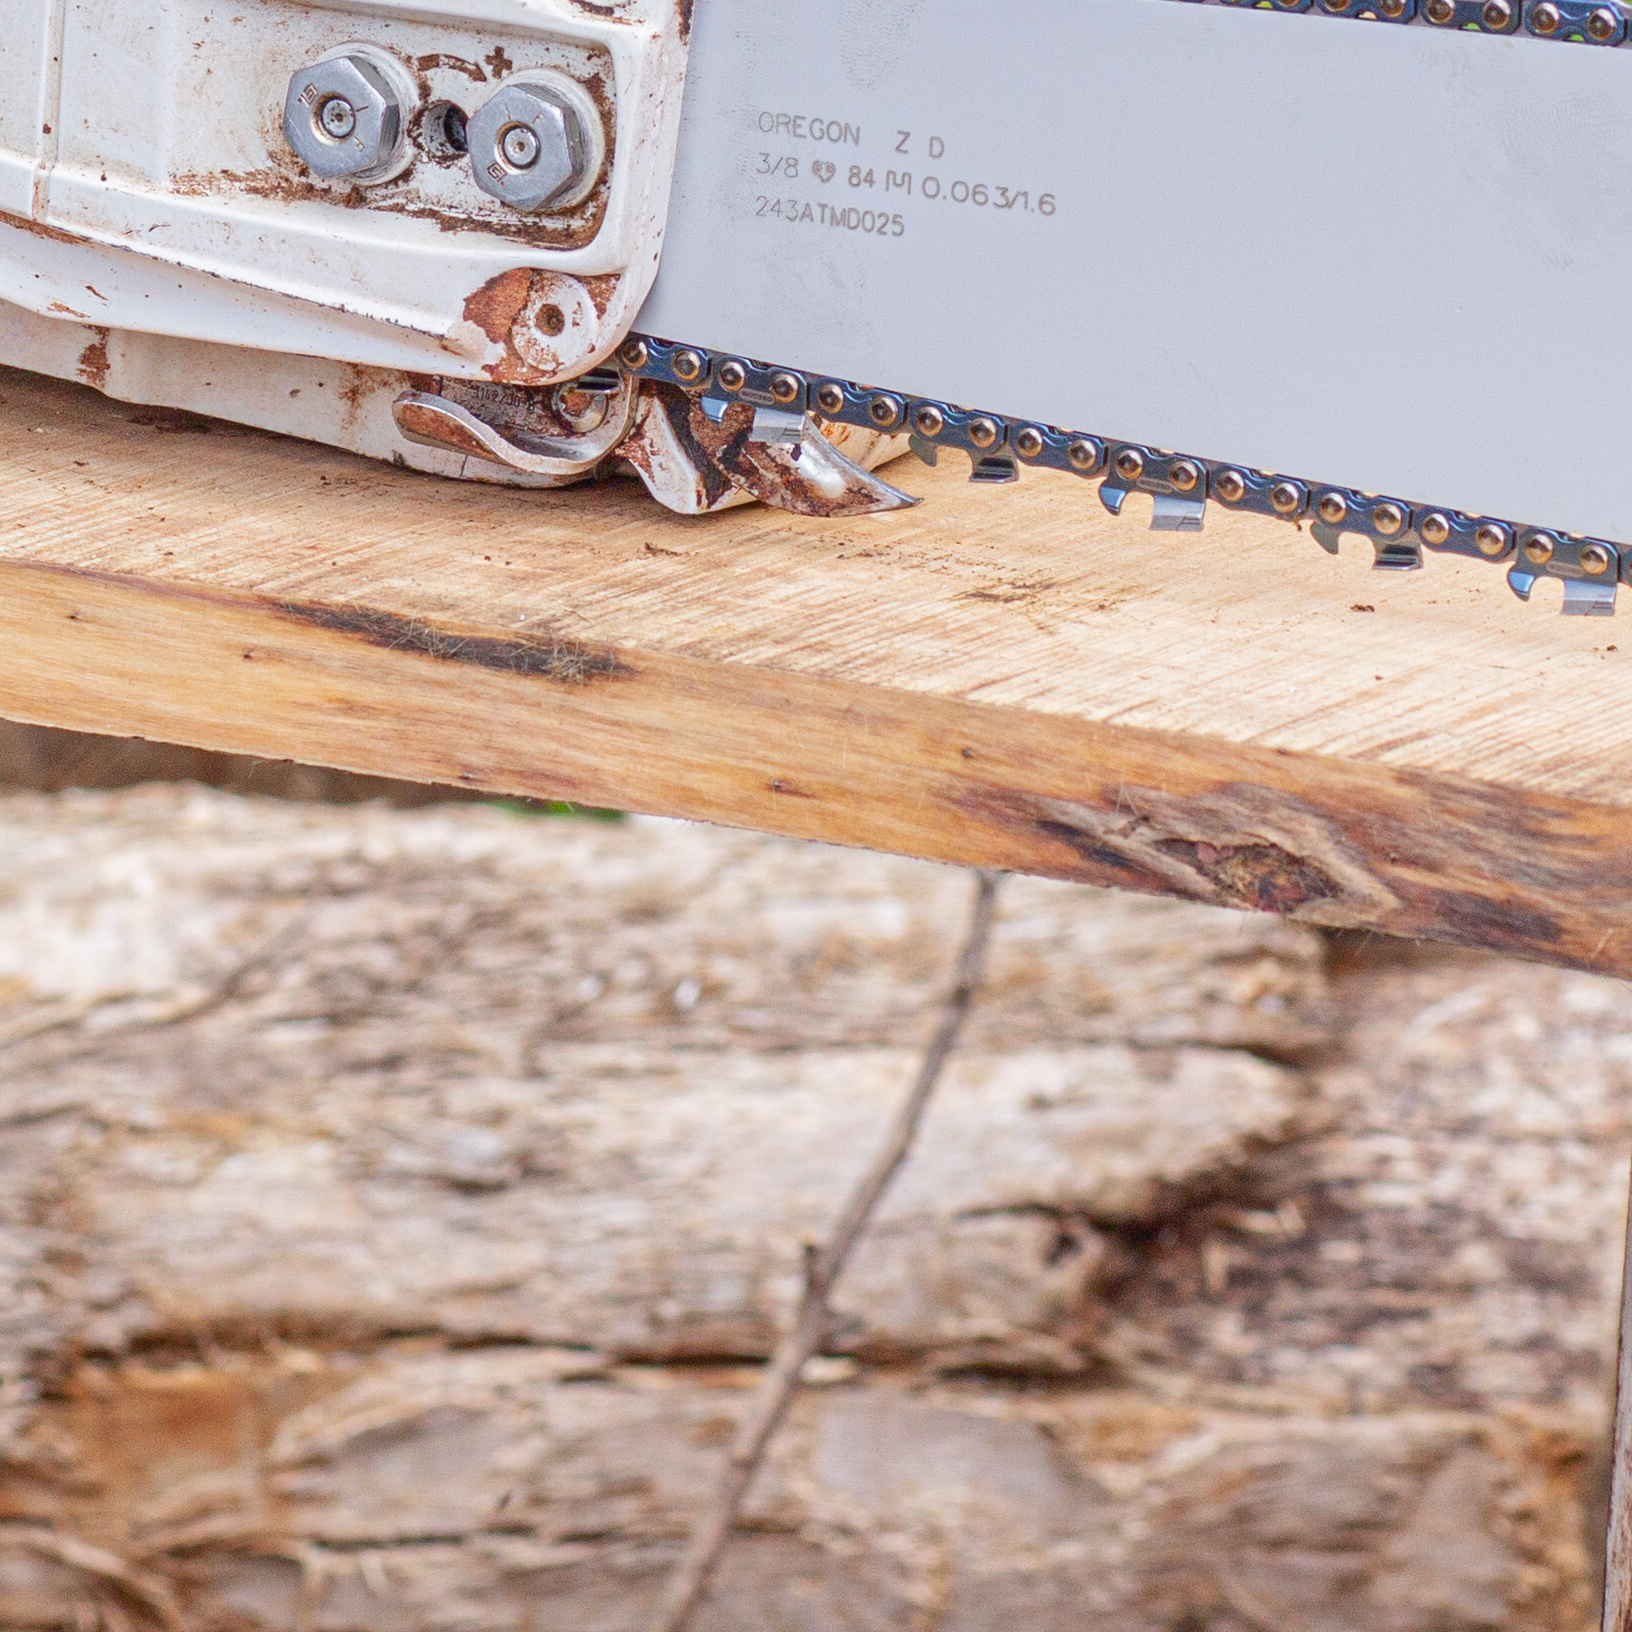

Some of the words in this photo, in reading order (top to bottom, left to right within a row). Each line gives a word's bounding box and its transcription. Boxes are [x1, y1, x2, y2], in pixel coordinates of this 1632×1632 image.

[758, 111, 861, 146] OREGON
[895, 130, 911, 154] Z
[929, 135, 945, 159] D
[756, 152, 799, 178] 3/8
[848, 164, 875, 188] 84
